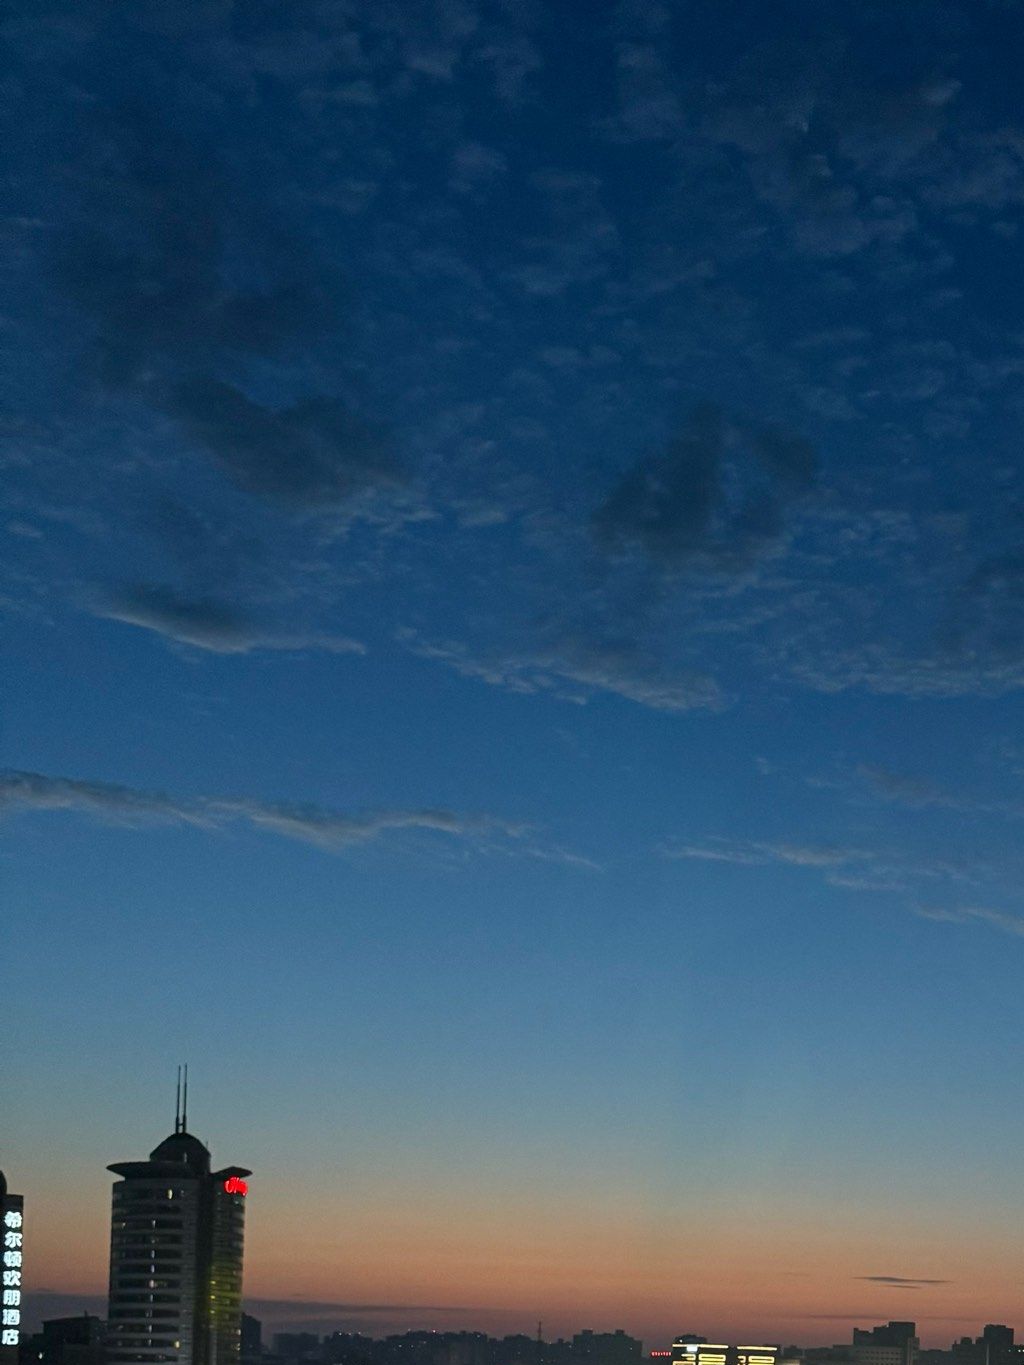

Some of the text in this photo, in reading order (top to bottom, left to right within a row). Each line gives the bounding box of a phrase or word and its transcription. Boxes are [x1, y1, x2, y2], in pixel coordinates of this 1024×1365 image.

[2, 1211, 23, 1346] 希尔顿欢朋酒店
